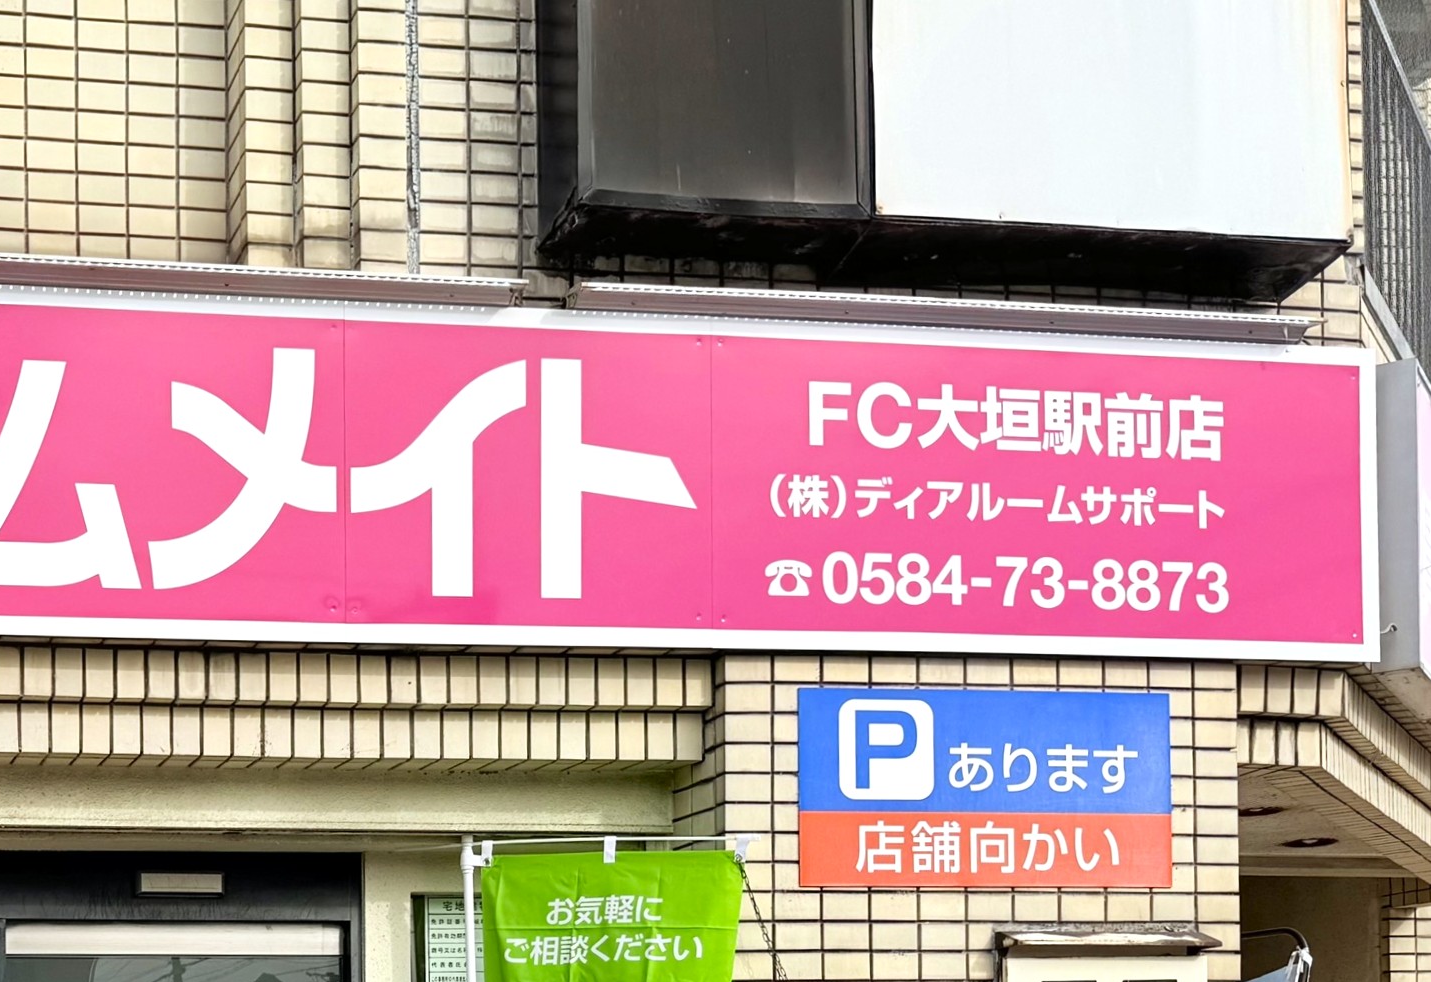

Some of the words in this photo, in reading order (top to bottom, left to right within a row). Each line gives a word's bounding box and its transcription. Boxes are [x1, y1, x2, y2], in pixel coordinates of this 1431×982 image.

[808, 380, 1225, 462] FC大垣駅前店
[821, 550, 1230, 614] 0584-73-8873
[948, 742, 1139, 794] あります
[855, 820, 1121, 875] 店舗向かい
[546, 895, 664, 925] お気軽に
[503, 934, 703, 966] ご相談ください
